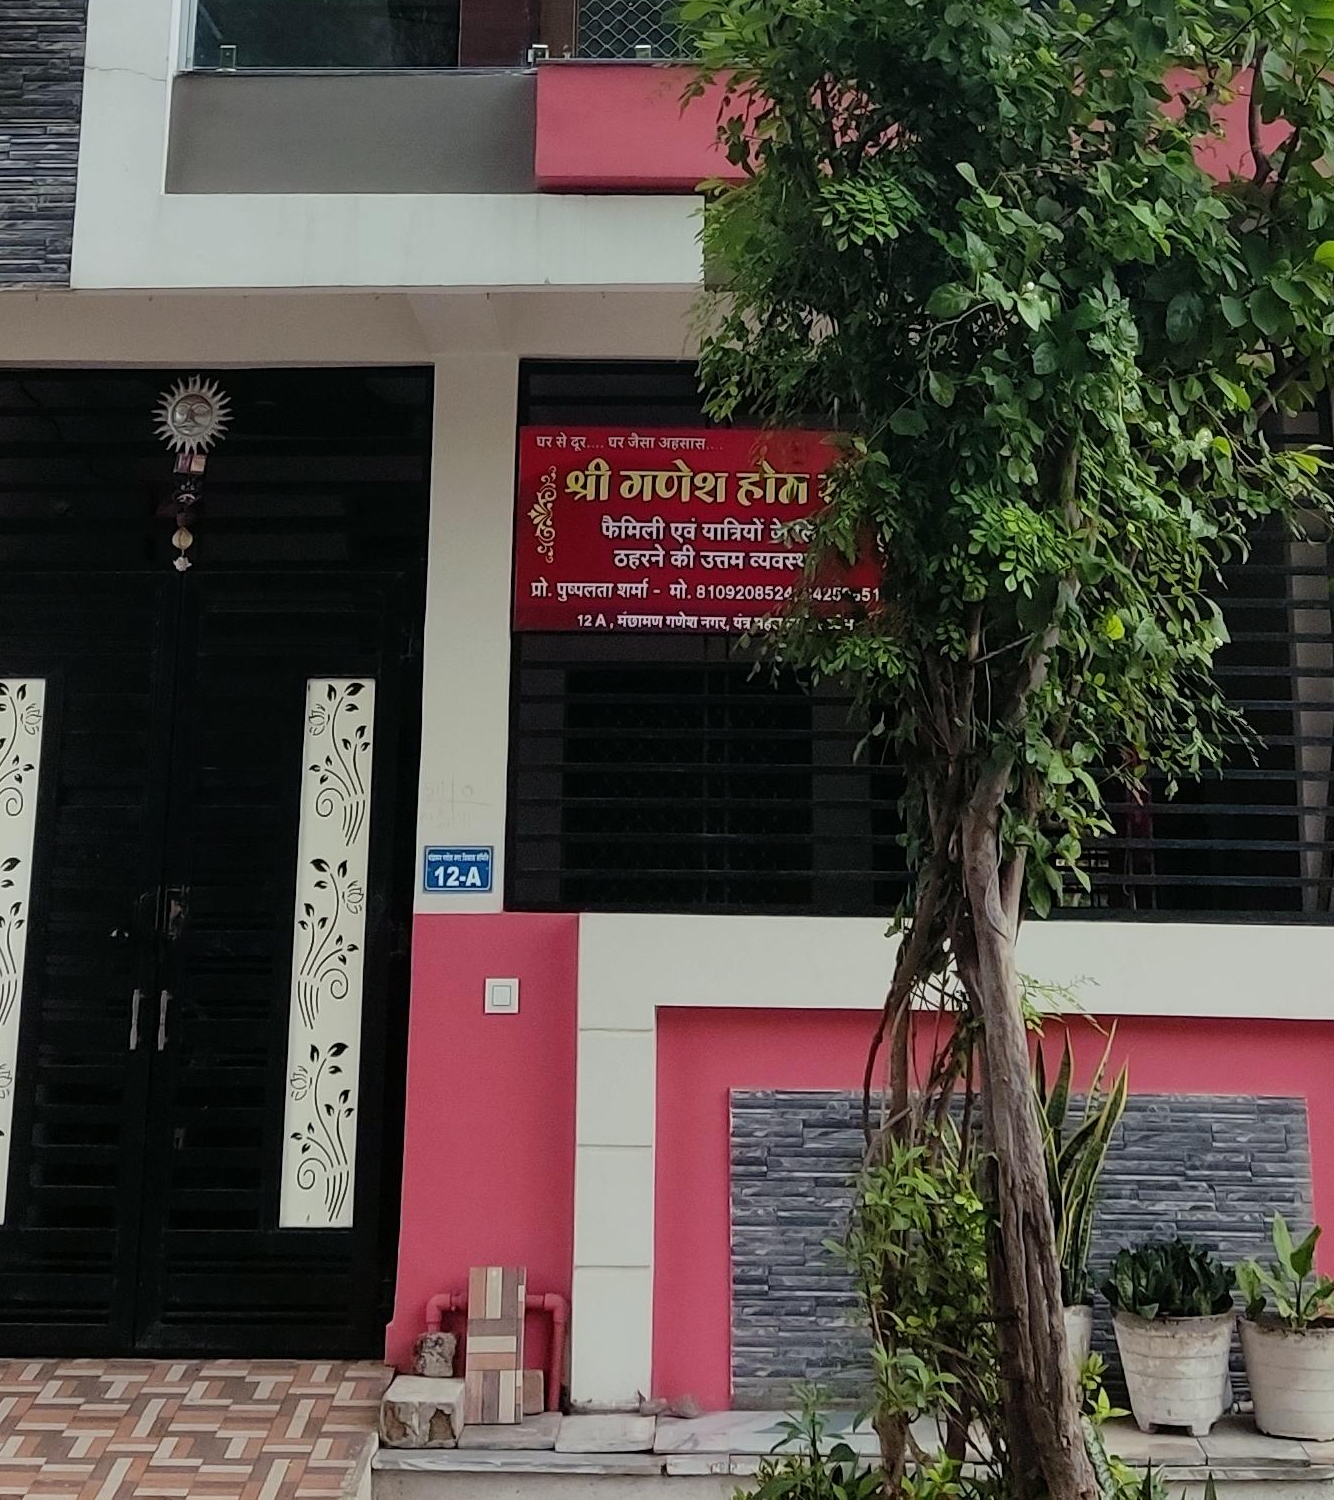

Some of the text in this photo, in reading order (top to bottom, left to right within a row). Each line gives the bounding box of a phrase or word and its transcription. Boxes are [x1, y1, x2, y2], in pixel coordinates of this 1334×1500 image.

[536, 436, 552, 447] घर
[556, 432, 567, 447] से
[608, 436, 624, 448] घर
[627, 432, 654, 449] जैसा
[565, 457, 612, 501] श्री
[619, 458, 729, 504] गणेश
[736, 460, 810, 507] होम
[601, 515, 665, 540] फैमिली
[669, 517, 698, 543] एवं
[702, 517, 765, 541] यात्रियों
[613, 544, 665, 569] ठहरने
[669, 544, 696, 569] की
[700, 552, 746, 569] उत्तम
[531, 576, 552, 598] प्रो.
[557, 582, 614, 602] पुष्पलता
[616, 578, 649, 599] शर्मा
[669, 579, 692, 599] मो.
[665, 611, 699, 629] गणेश
[434, 866, 482, 886] 12-A
